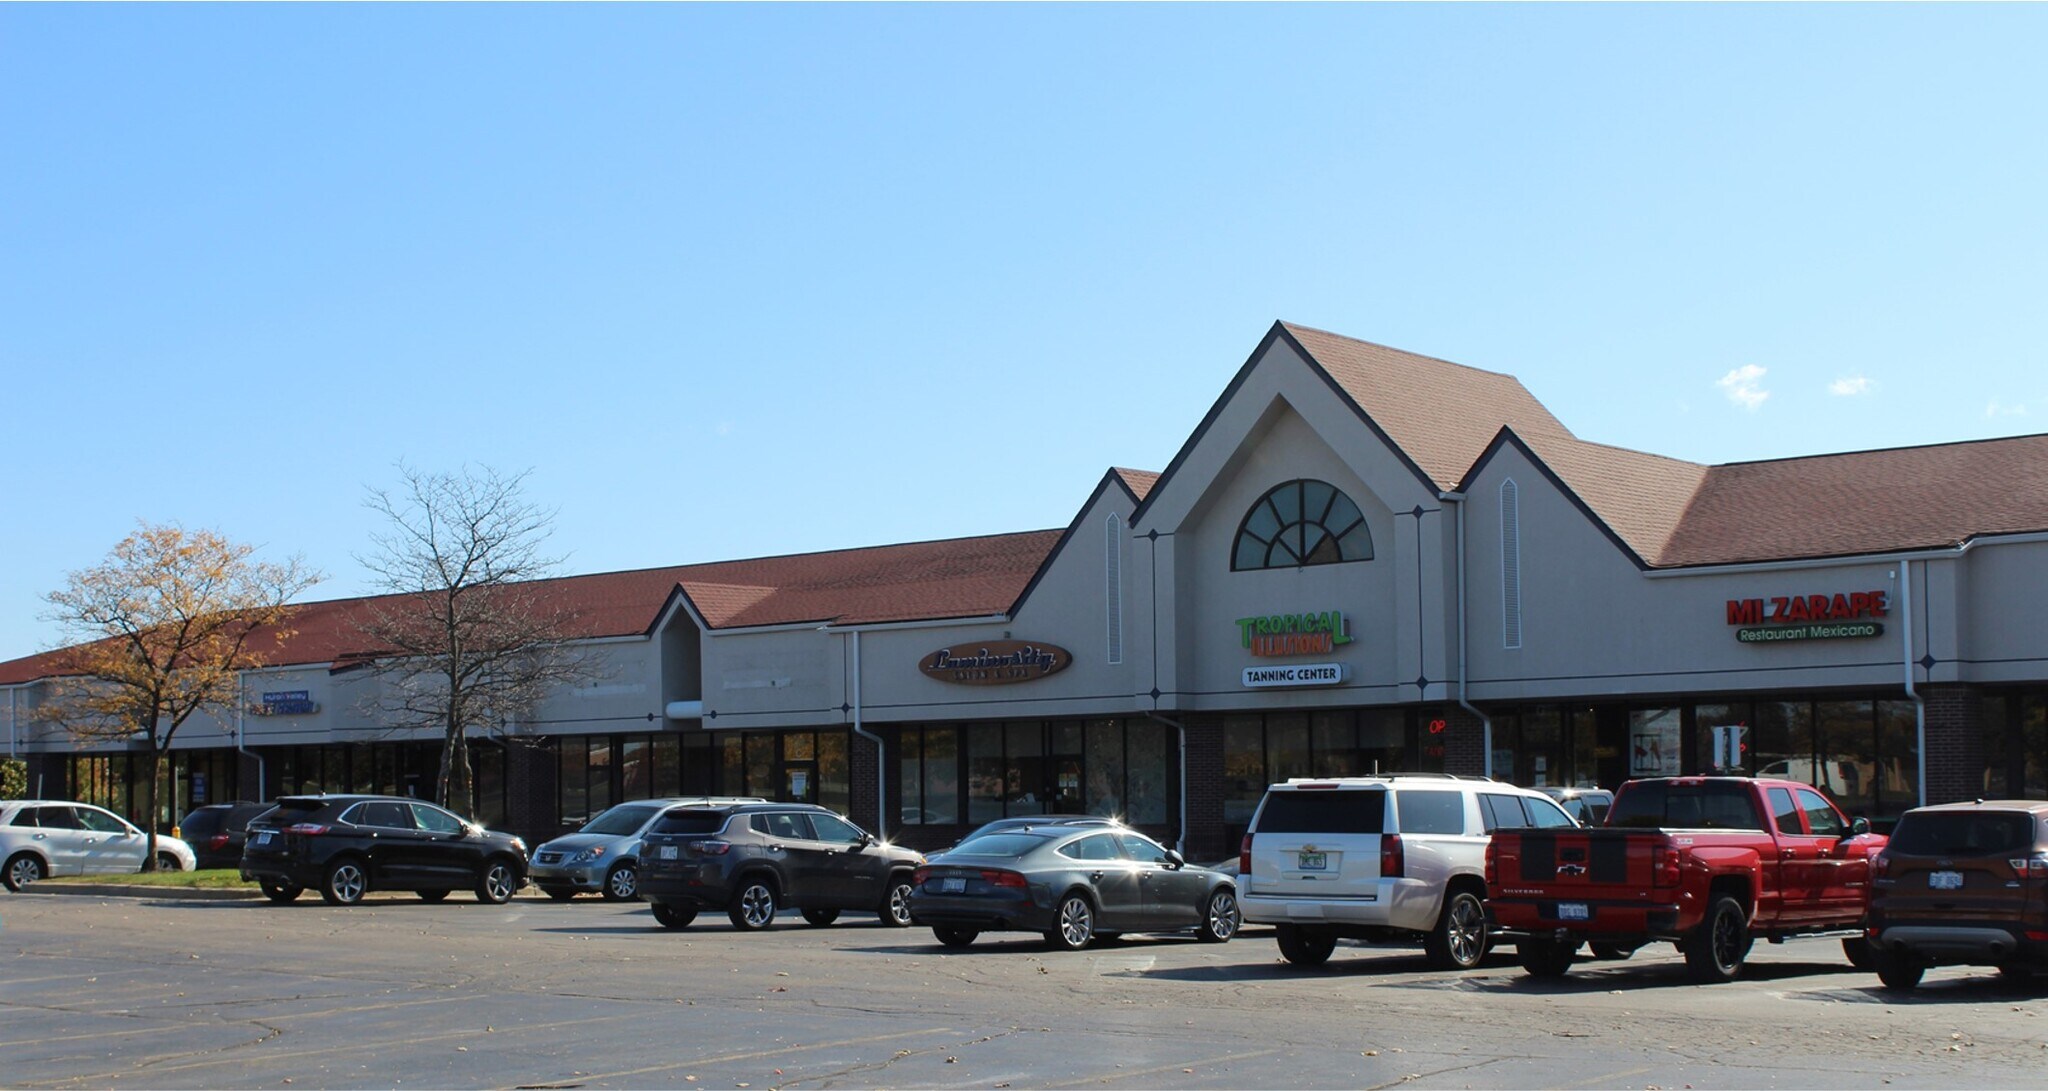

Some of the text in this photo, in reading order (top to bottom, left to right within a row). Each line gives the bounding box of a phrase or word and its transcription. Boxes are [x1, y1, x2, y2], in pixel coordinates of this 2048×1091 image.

[1727, 590, 1886, 625] MI ZARAPE
[1235, 611, 1352, 648] TROPICAL
[1740, 625, 1875, 641] Restaurant Mexicano
[1251, 633, 1333, 657] ILLUSIONS
[1247, 668, 1336, 682] TANNING CENTER
